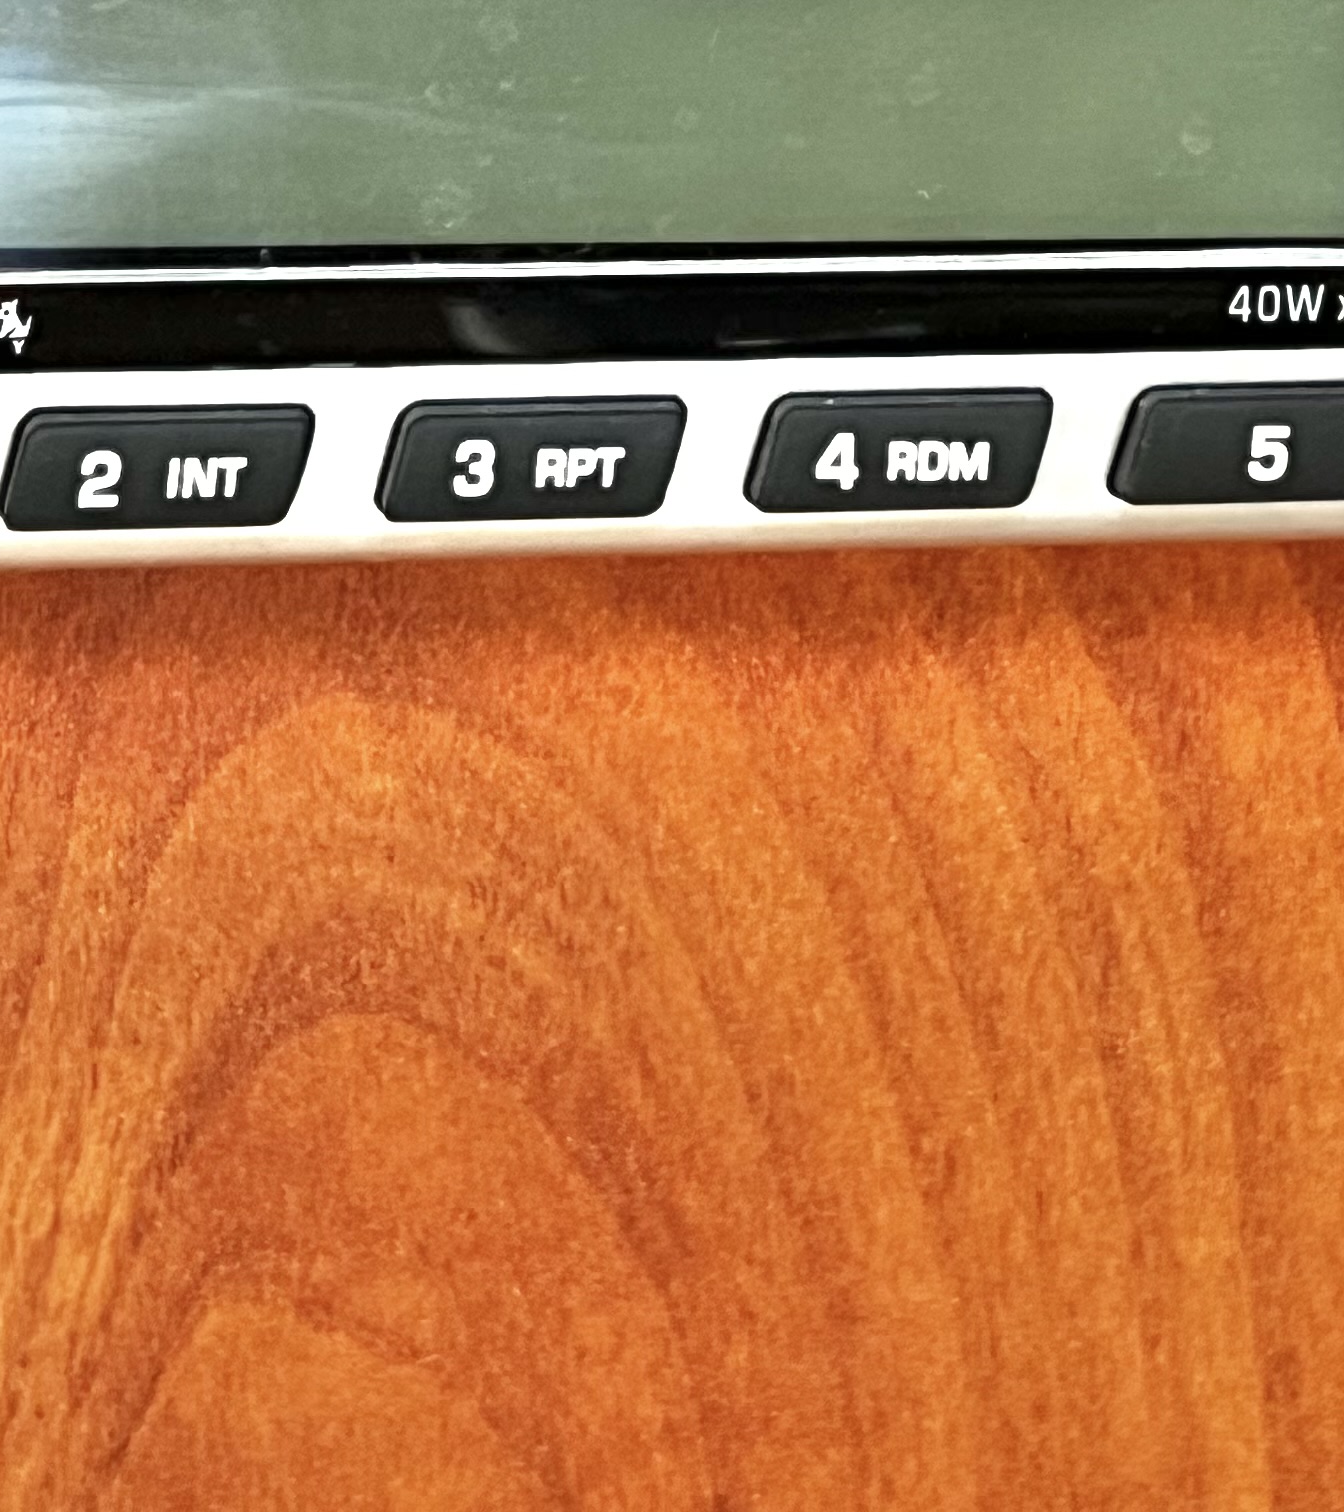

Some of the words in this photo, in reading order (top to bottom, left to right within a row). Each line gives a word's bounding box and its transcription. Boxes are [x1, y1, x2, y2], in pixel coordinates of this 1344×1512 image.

[1228, 283, 1325, 323] 40W
[77, 449, 123, 509] 2
[165, 456, 248, 500] INT
[452, 439, 496, 498] 3
[534, 446, 627, 489] RPT
[814, 432, 860, 491] 4
[886, 440, 991, 482] RDM
[1247, 424, 1292, 482] 5
